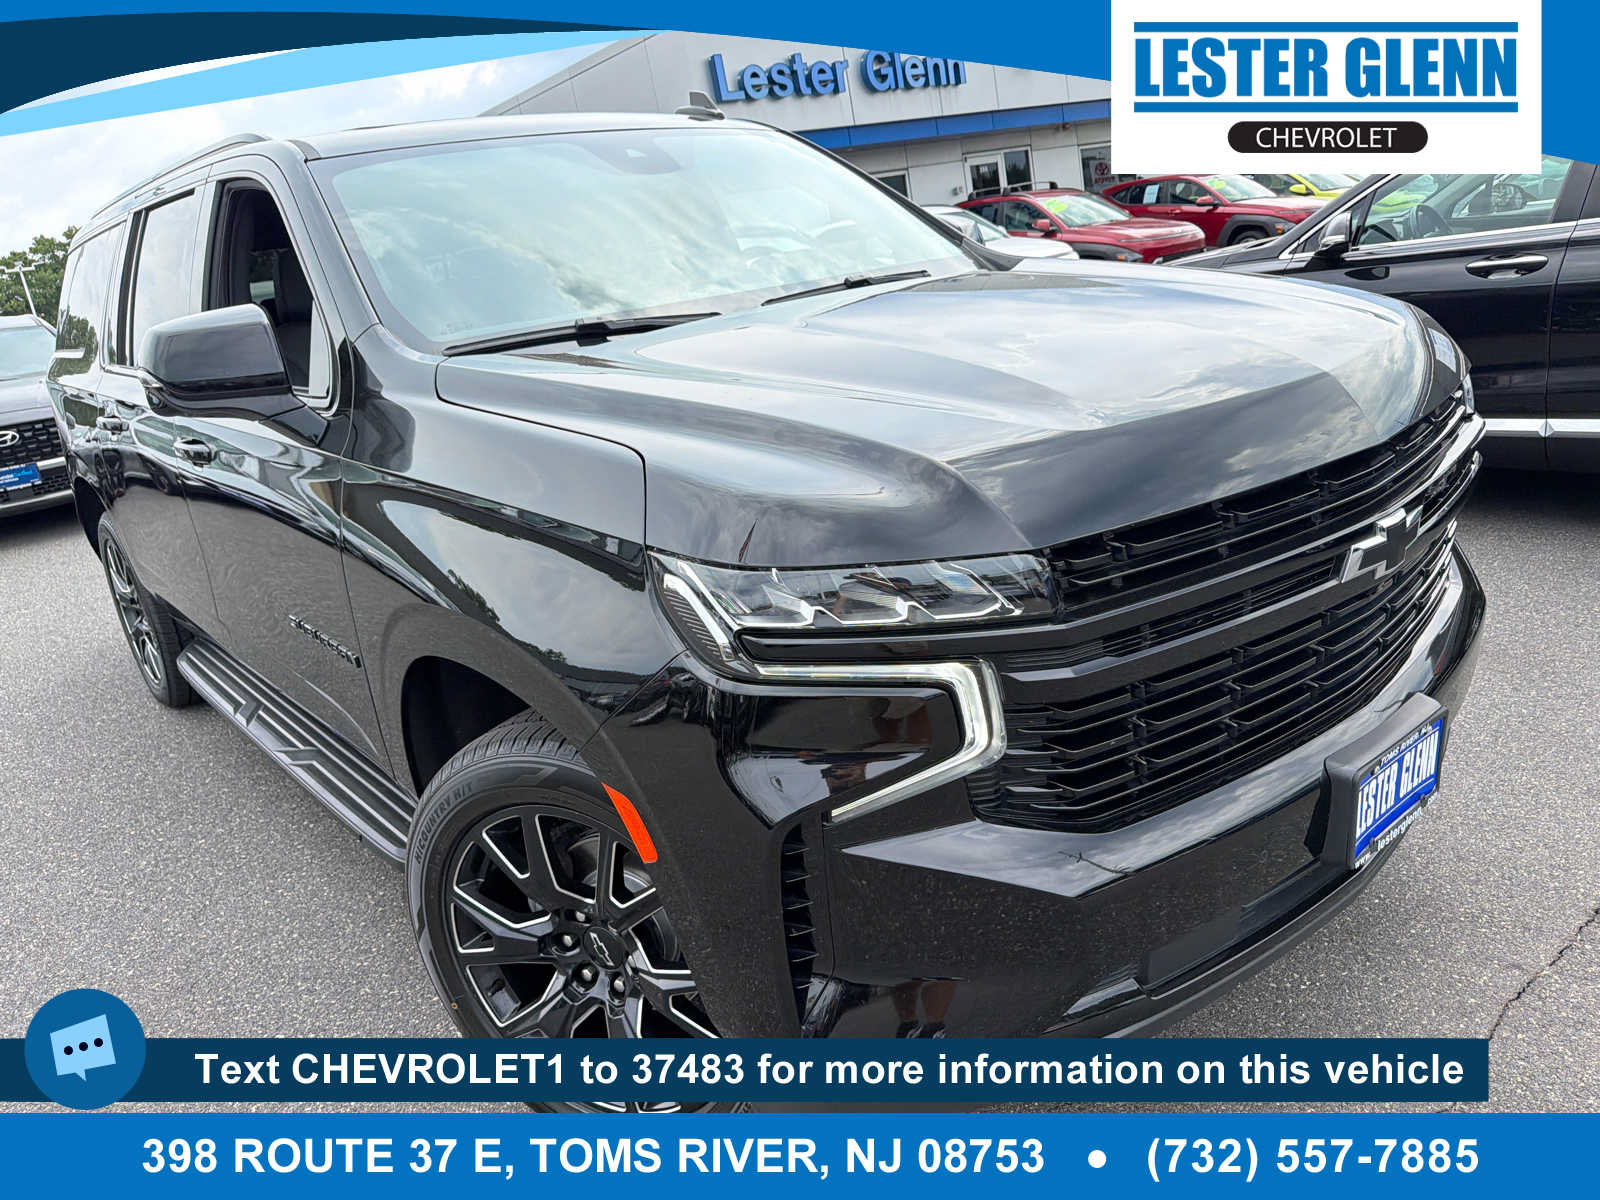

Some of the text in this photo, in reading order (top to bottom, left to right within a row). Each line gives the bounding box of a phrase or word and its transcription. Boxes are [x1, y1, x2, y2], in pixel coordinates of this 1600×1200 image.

[709, 50, 967, 101] Lester Glenn
[1356, 731, 1440, 839] LESTER GLENN
